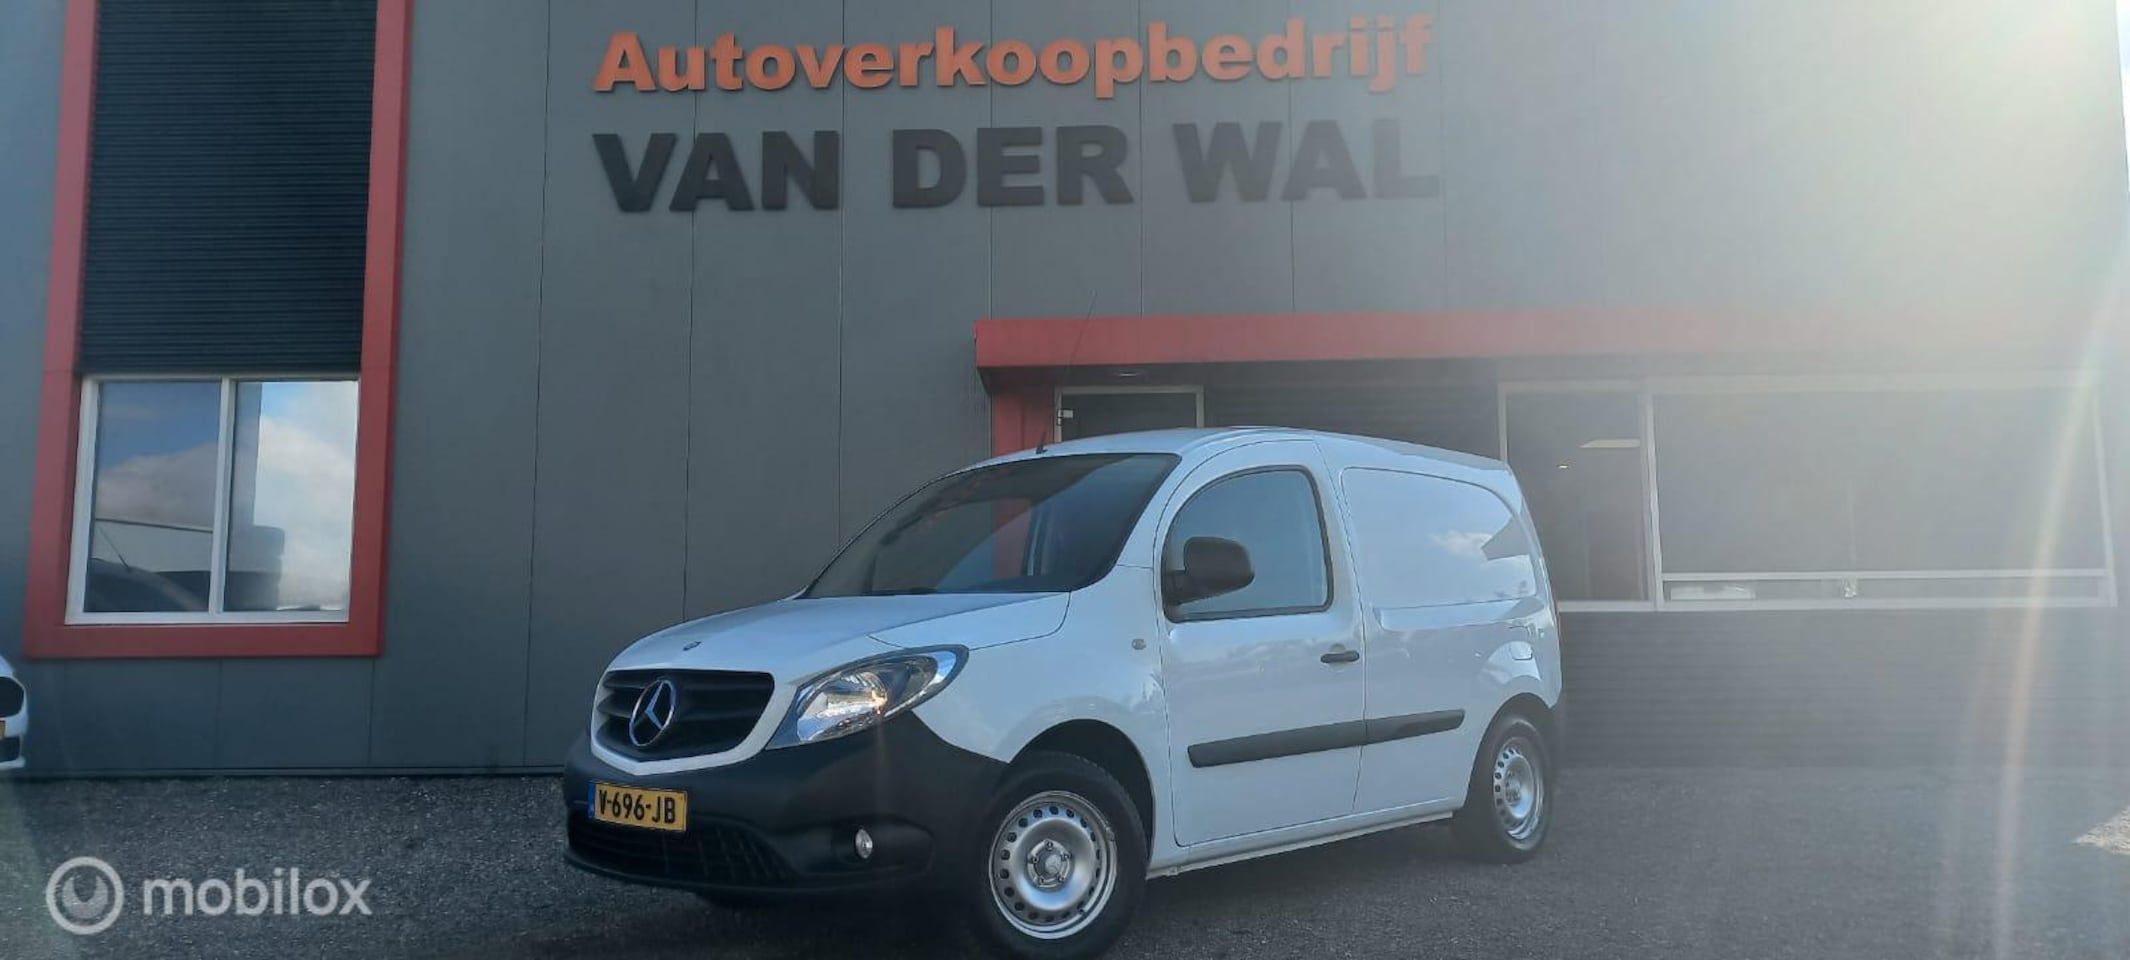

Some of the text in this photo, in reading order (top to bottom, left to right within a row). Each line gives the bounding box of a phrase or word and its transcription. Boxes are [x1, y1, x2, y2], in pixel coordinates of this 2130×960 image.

[593, 14, 1433, 99] Autoverkoopbedrijf
[593, 119, 1440, 212] VAN DER WAL
[598, 789, 676, 823] V-696-JB
